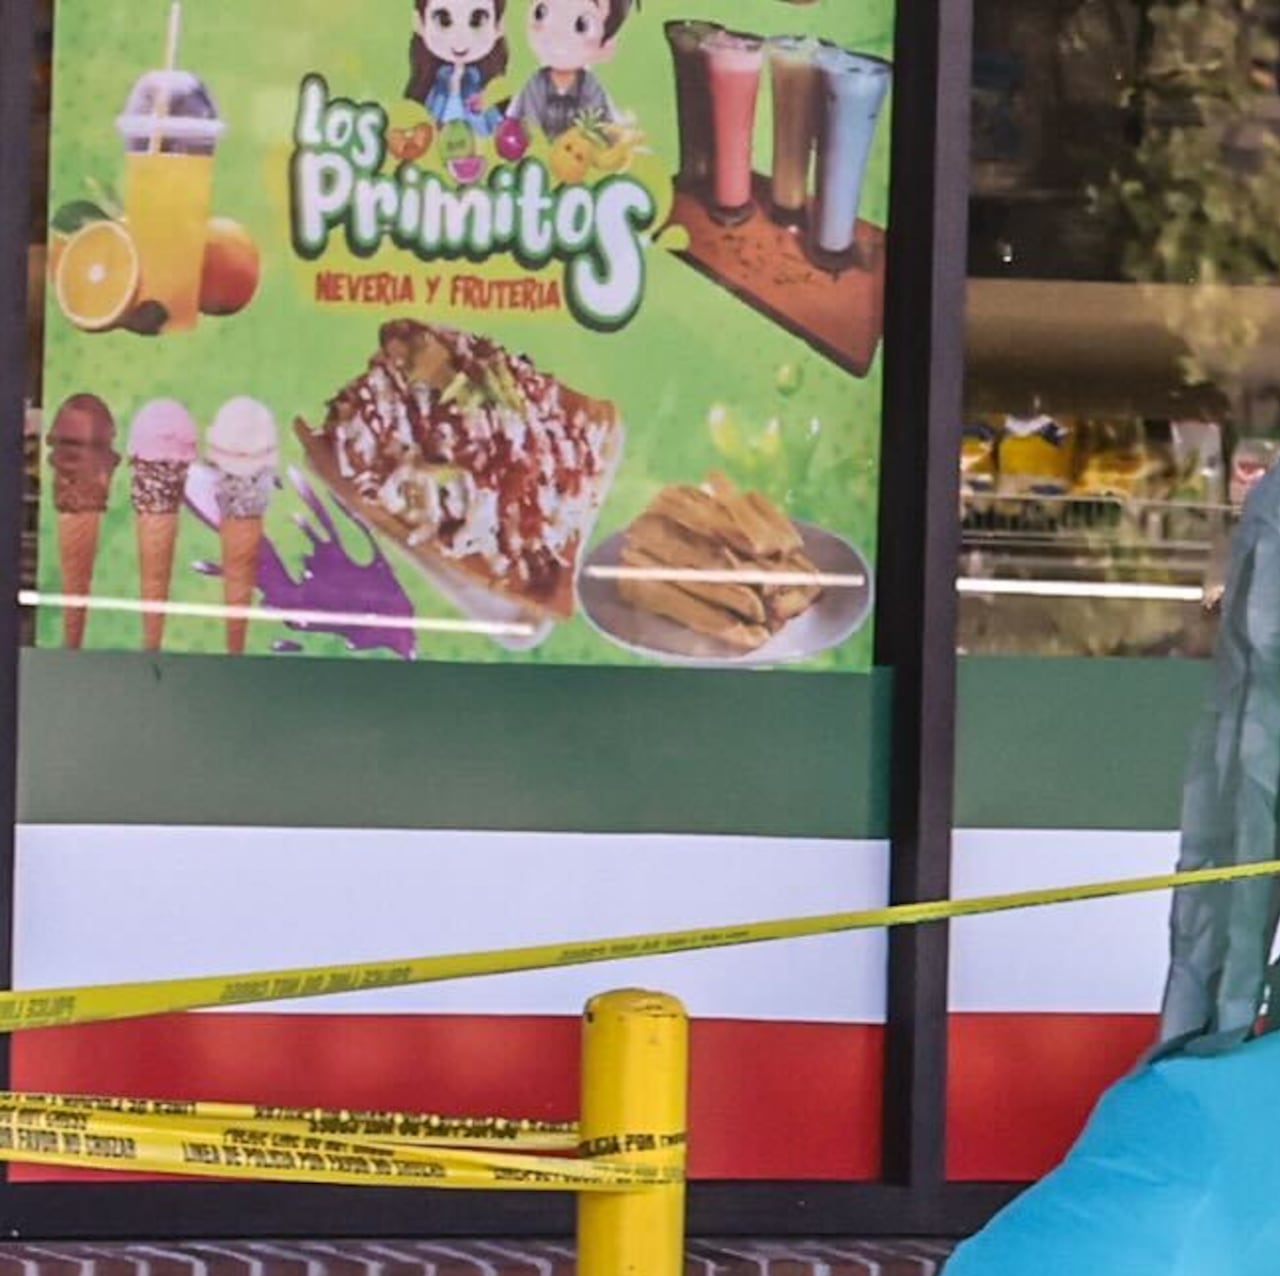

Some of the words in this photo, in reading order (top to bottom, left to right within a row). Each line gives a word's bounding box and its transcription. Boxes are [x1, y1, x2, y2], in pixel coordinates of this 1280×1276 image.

[298, 77, 386, 171] Los
[296, 158, 655, 325] Primitos
[315, 271, 415, 305] NEVERIA
[426, 275, 441, 305] Y
[450, 275, 561, 311] FRUTERIA
